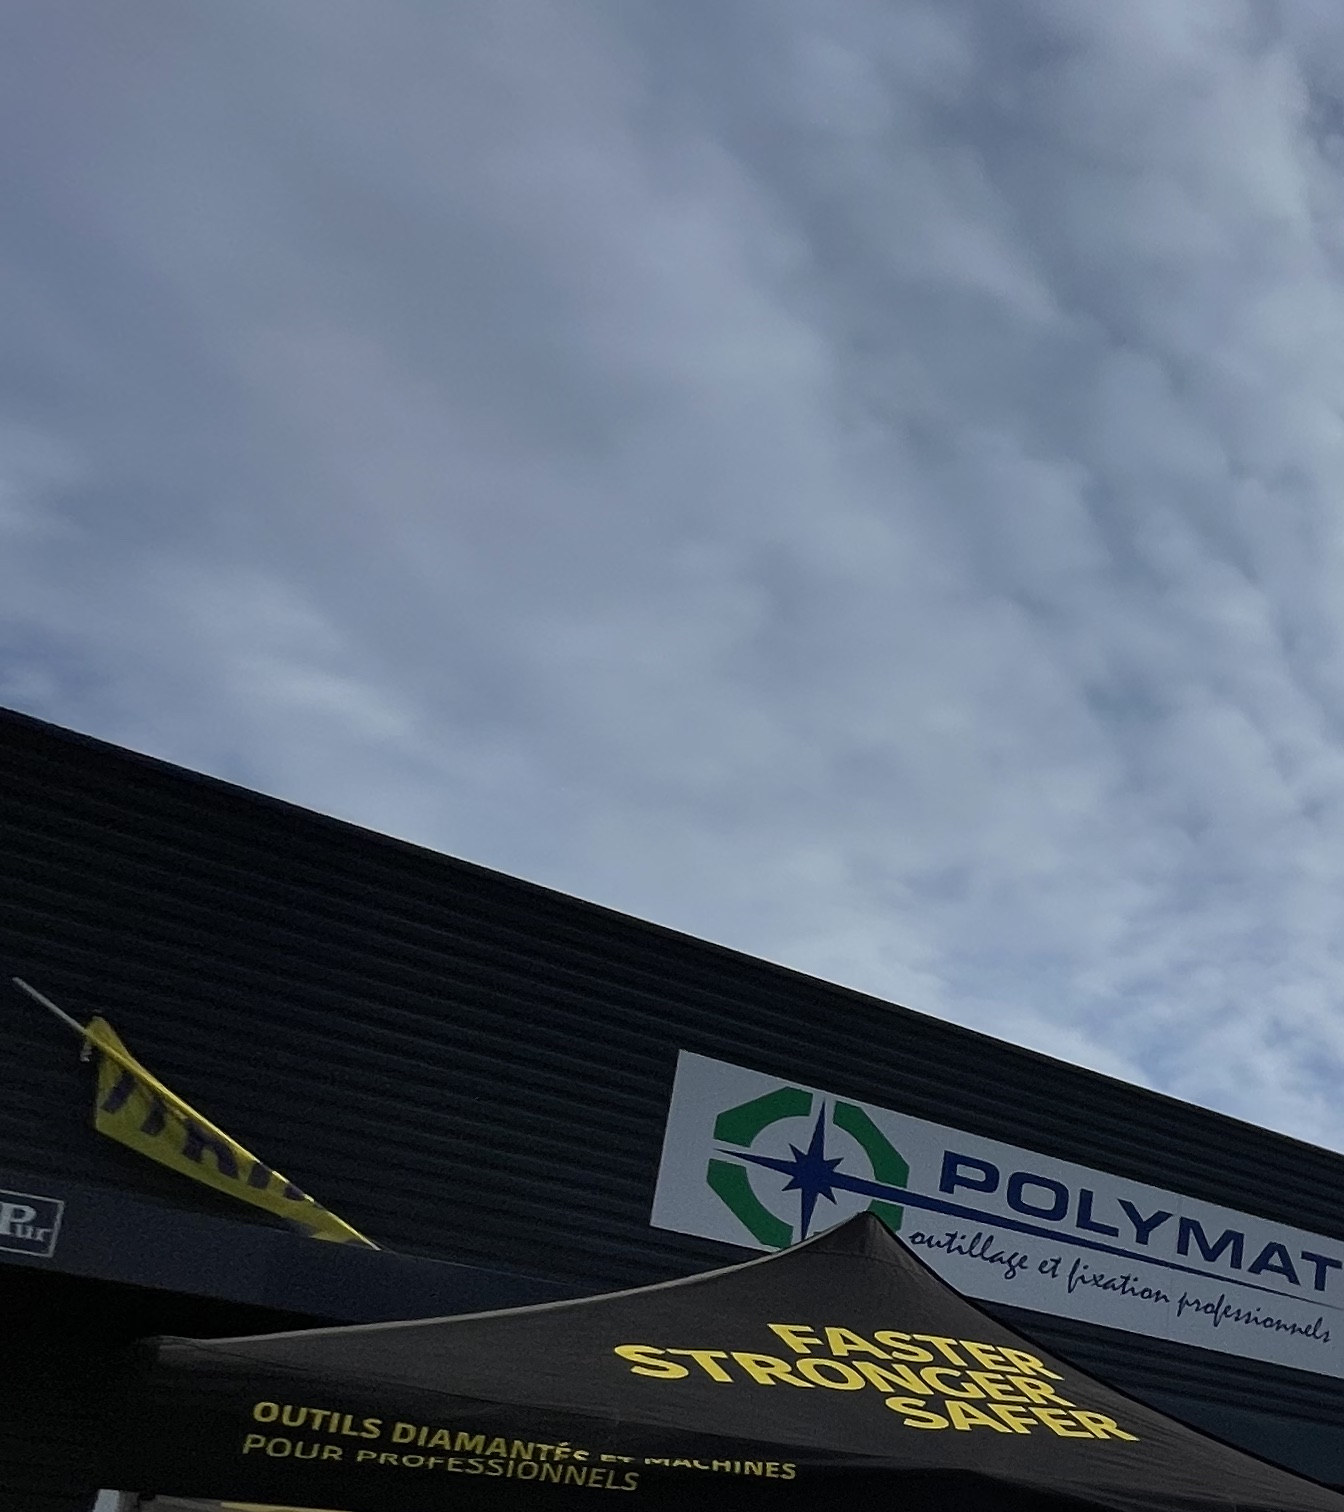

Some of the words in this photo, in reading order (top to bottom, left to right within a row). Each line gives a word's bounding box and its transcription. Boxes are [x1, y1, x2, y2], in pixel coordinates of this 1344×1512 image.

[939, 1150, 1343, 1291] POLYMAT
[908, 1229, 1028, 1279] outillage
[1038, 1255, 1062, 1278] et
[1068, 1258, 1170, 1304] fixation
[1177, 1292, 1331, 1343] professionnels
[614, 1344, 1076, 1407] STRONGER
[767, 1322, 1065, 1381] FASTER
[253, 1401, 382, 1439] OUTILS
[885, 1396, 1140, 1441] SAFER
[242, 1433, 343, 1461] POUR
[356, 1450, 640, 1492] PROFESSIONNELS
